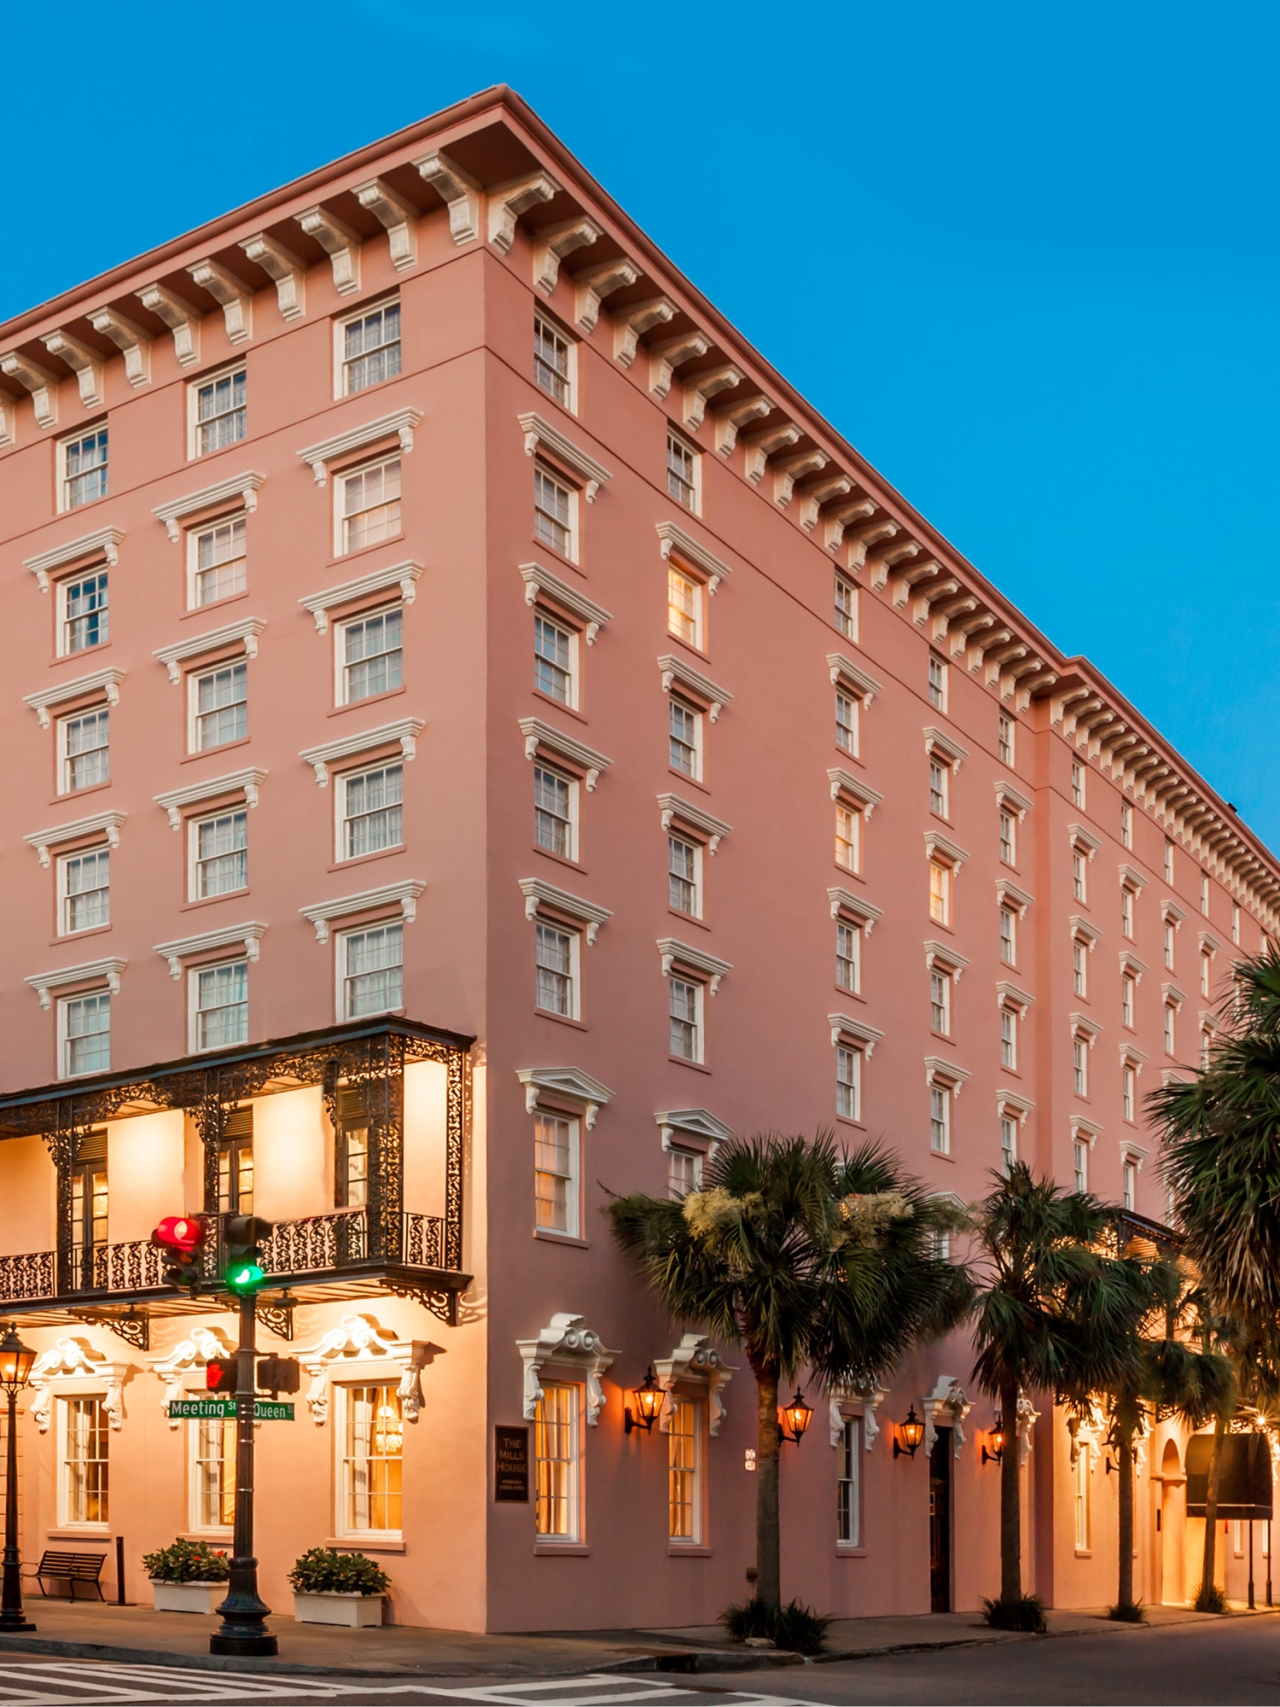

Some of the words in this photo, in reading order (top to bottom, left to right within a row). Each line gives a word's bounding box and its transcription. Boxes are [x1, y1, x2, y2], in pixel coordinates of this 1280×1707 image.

[171, 1401, 225, 1418] Meeting
[227, 1402, 237, 1411] St
[253, 1403, 286, 1418] Queen
[503, 1438, 522, 1449] THE
[499, 1450, 525, 1461] MILLS
[497, 1462, 528, 1473] HOUSE
